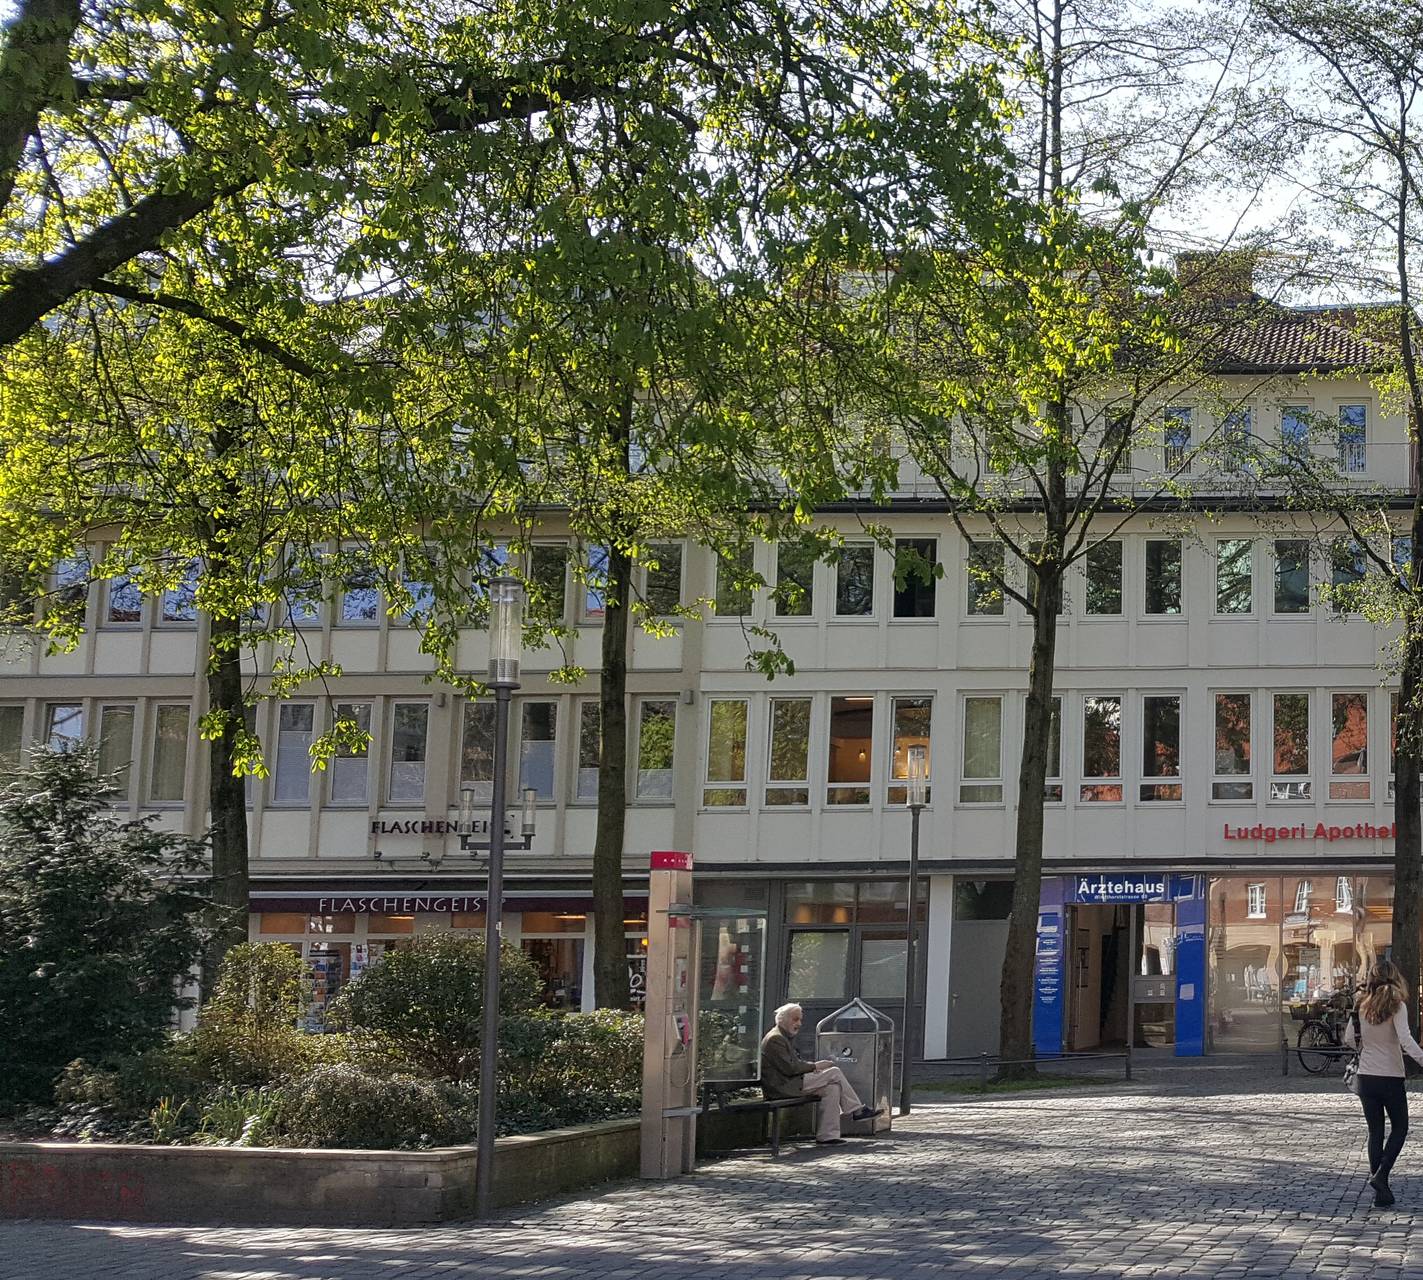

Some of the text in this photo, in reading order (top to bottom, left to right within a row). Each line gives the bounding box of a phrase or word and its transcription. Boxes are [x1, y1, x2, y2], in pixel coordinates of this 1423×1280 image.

[371, 820, 510, 834] FLASCHENEI
[1224, 823, 1305, 843] Ludgeri
[1078, 878, 1165, 894] Ärztehaus
